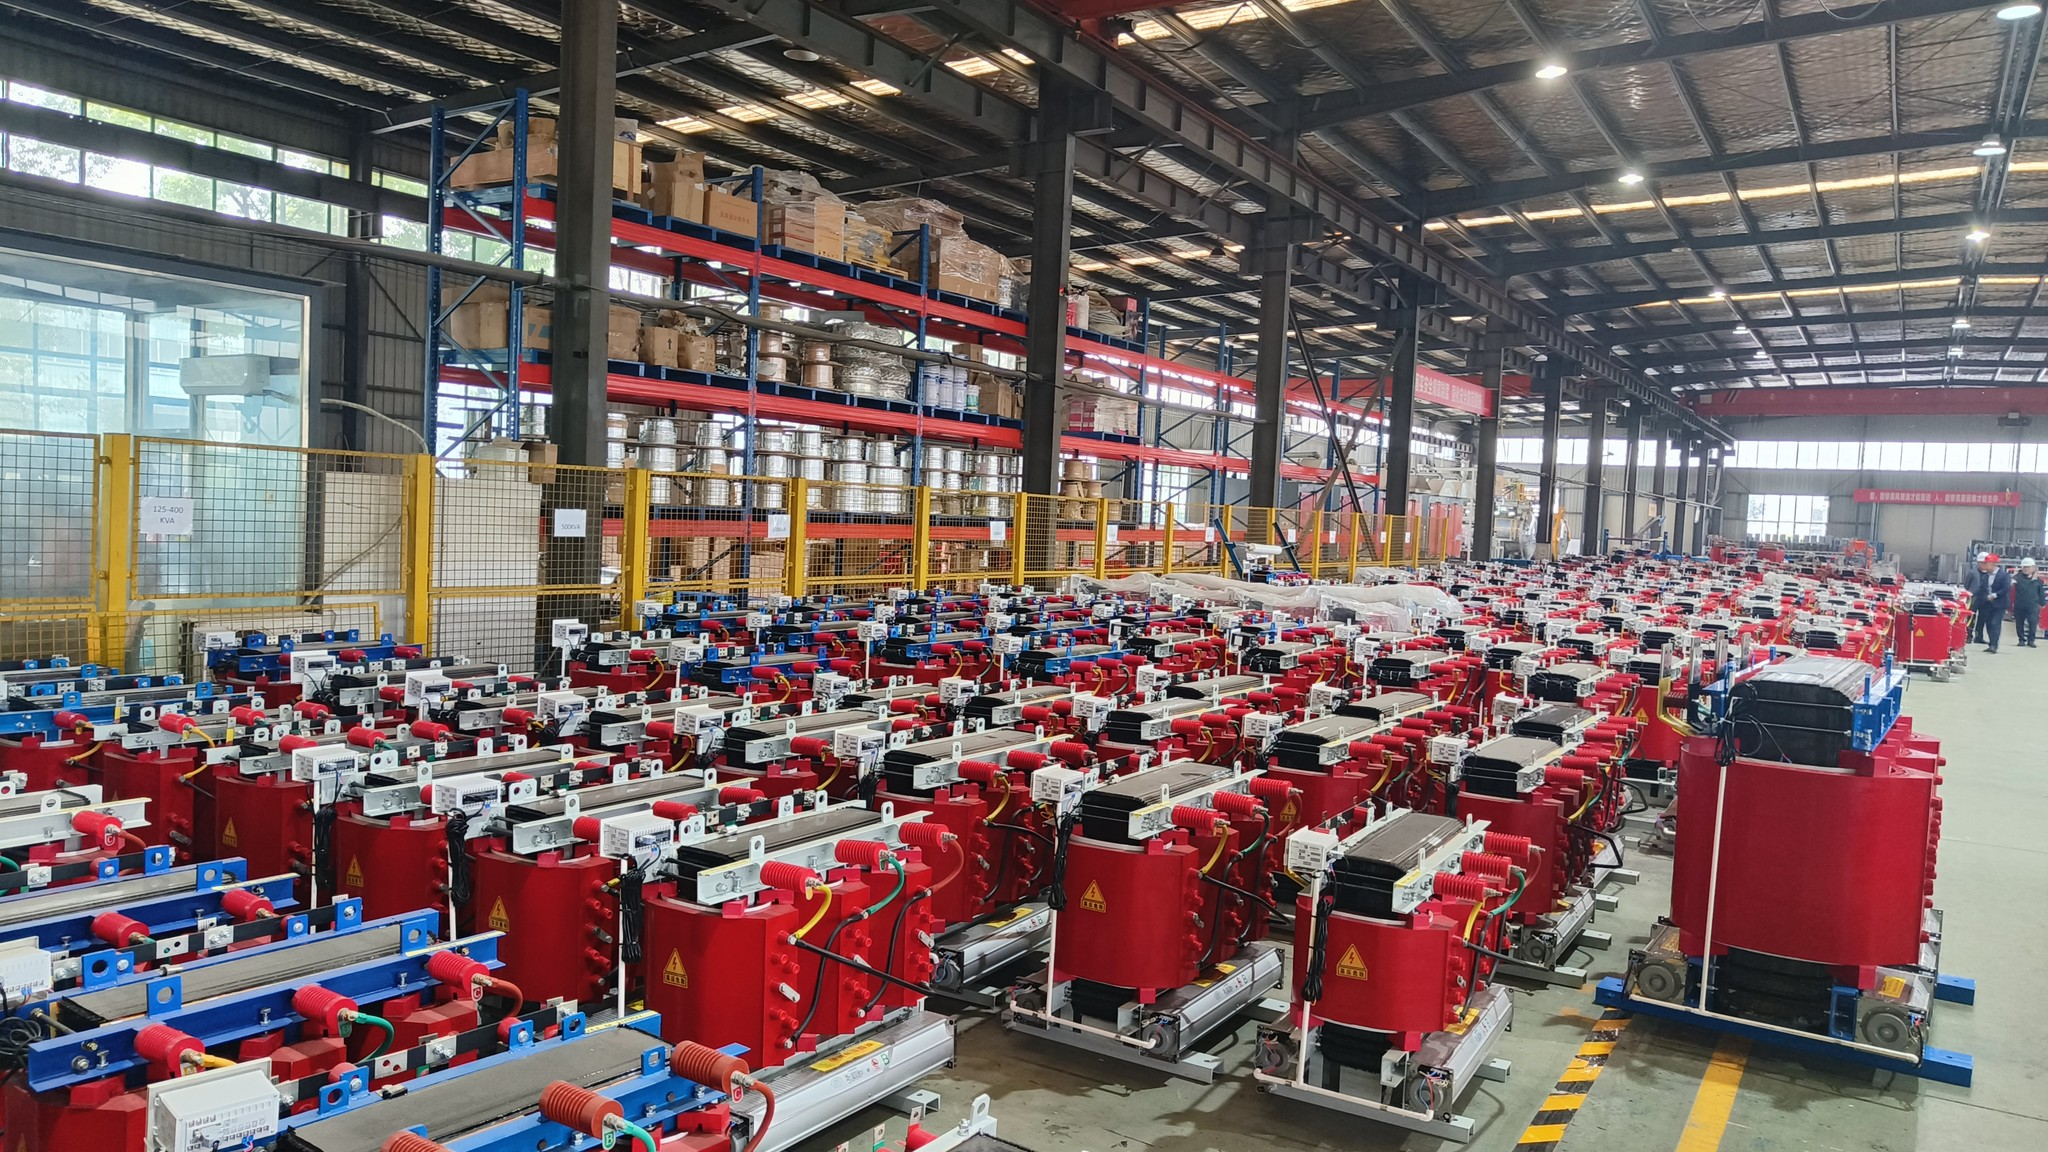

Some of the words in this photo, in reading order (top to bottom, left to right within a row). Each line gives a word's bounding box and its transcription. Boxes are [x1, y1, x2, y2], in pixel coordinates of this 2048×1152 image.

[153, 505, 184, 514] 125-400
[474, 988, 481, 998] C
[881, 1053, 890, 1066] B
[734, 1087, 741, 1099] C
[605, 1133, 614, 1146] B
